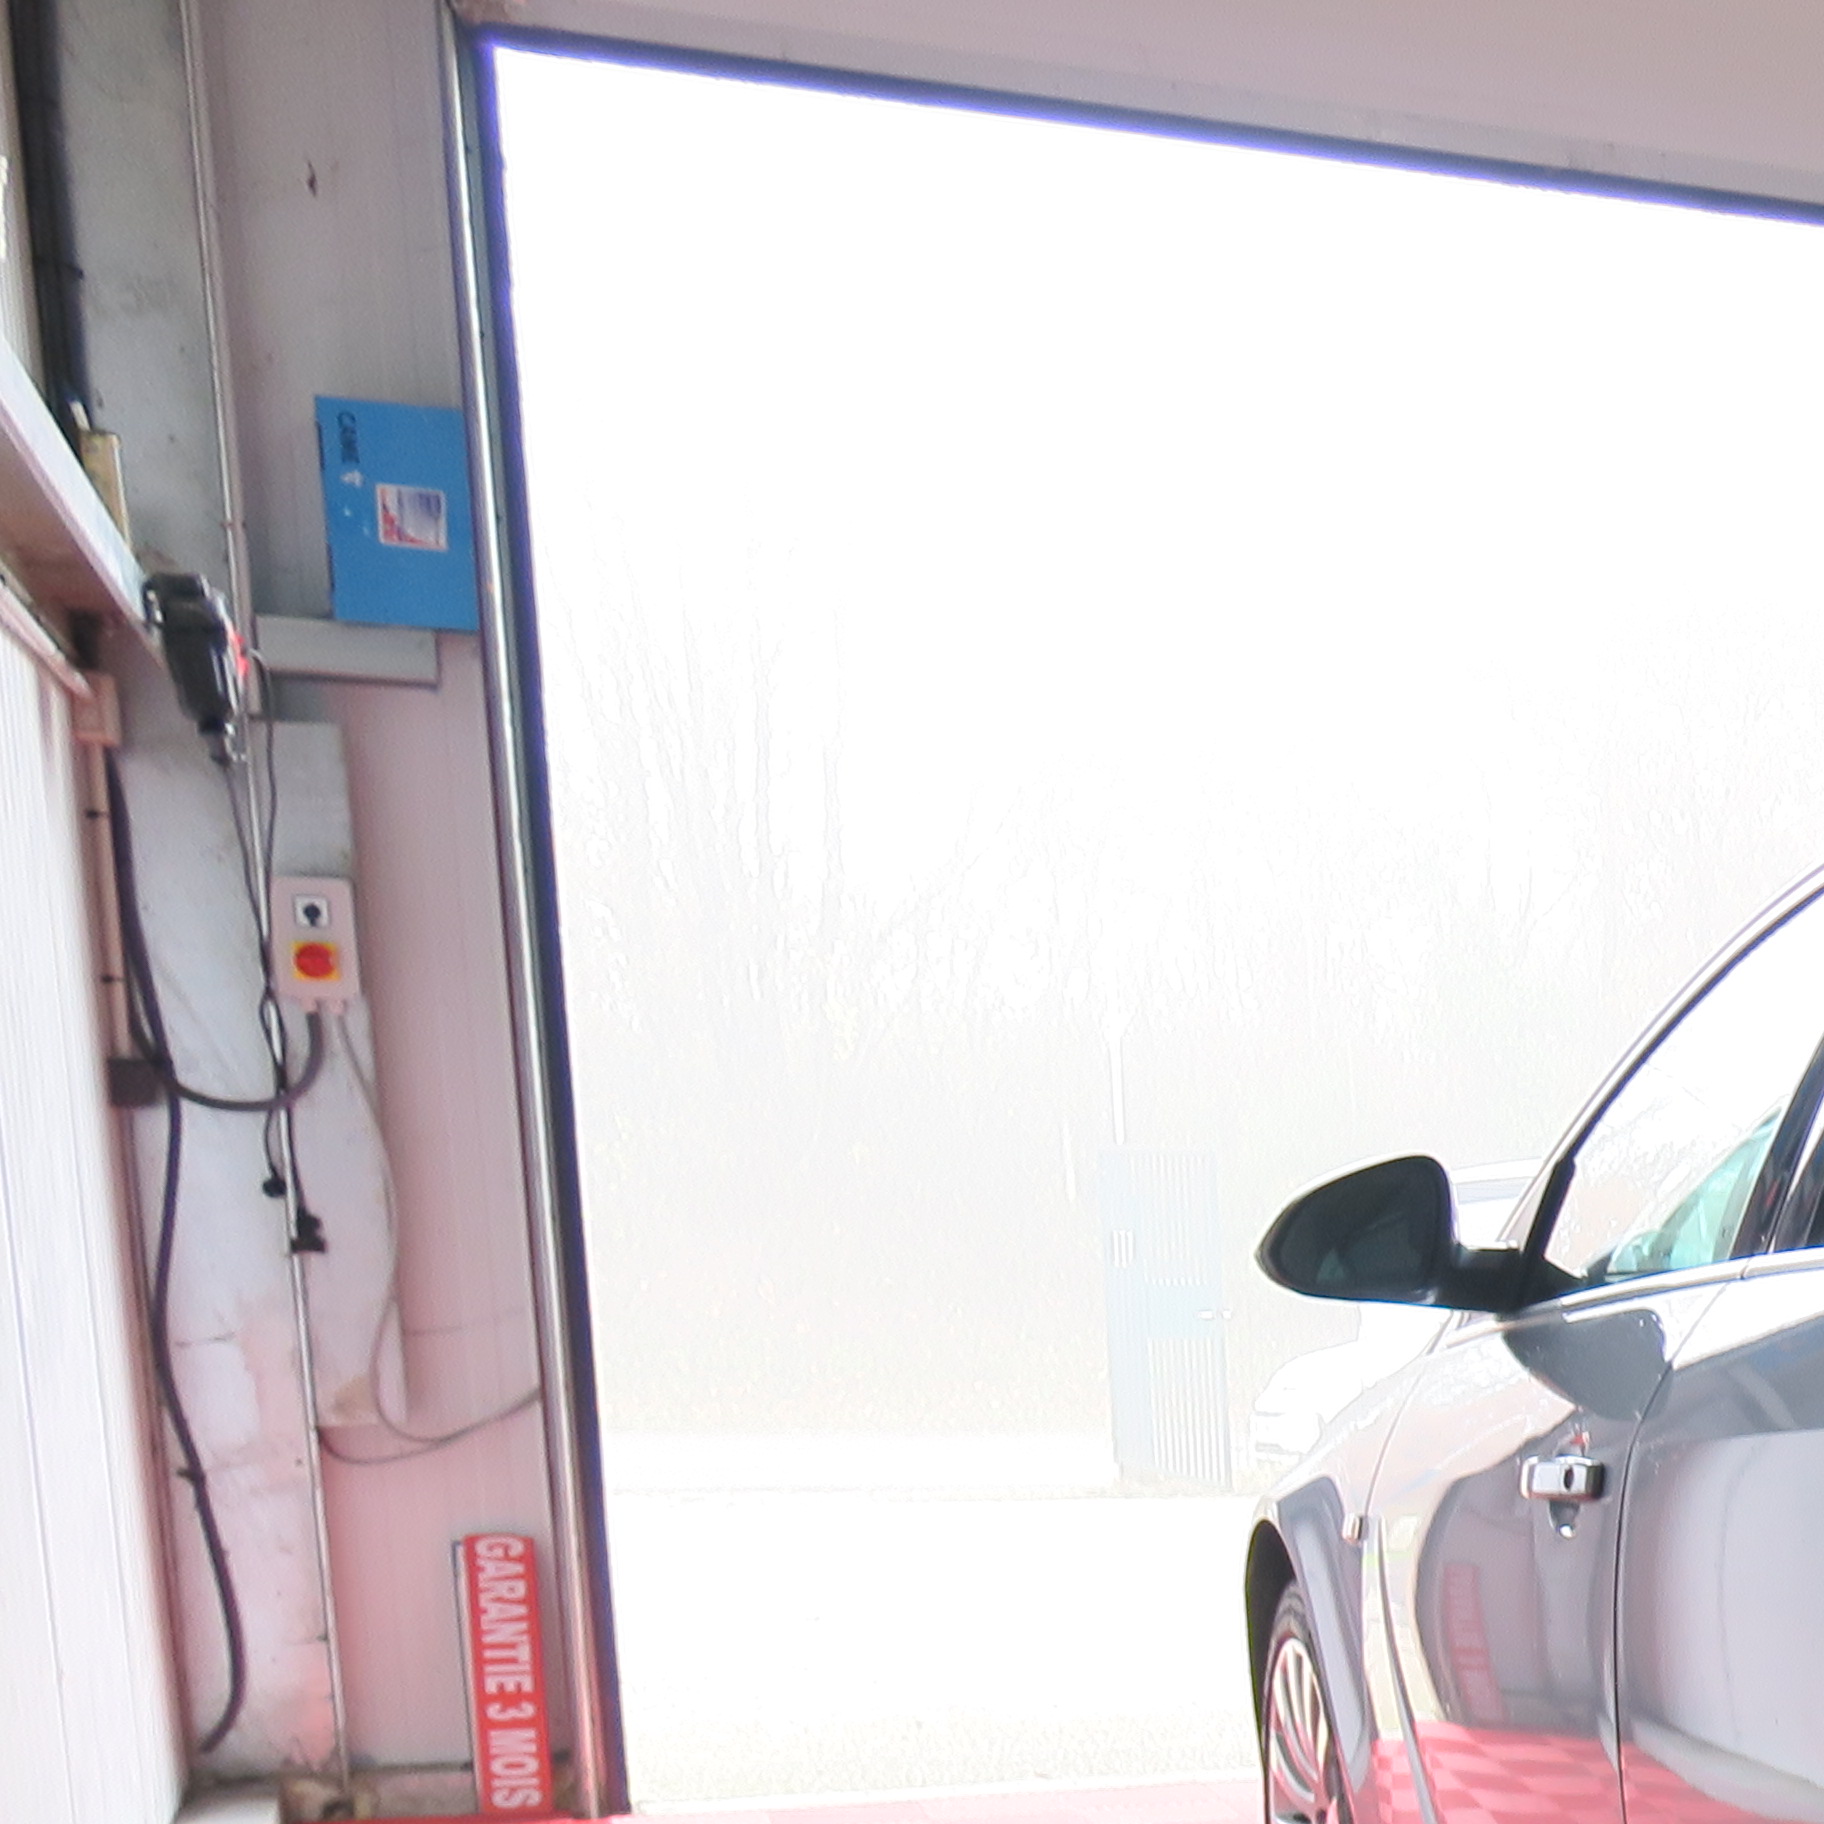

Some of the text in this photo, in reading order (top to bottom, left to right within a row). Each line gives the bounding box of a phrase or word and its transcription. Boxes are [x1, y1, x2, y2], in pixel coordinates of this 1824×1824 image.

[474, 1536, 543, 1810] GARANTIE 3 MOIS
